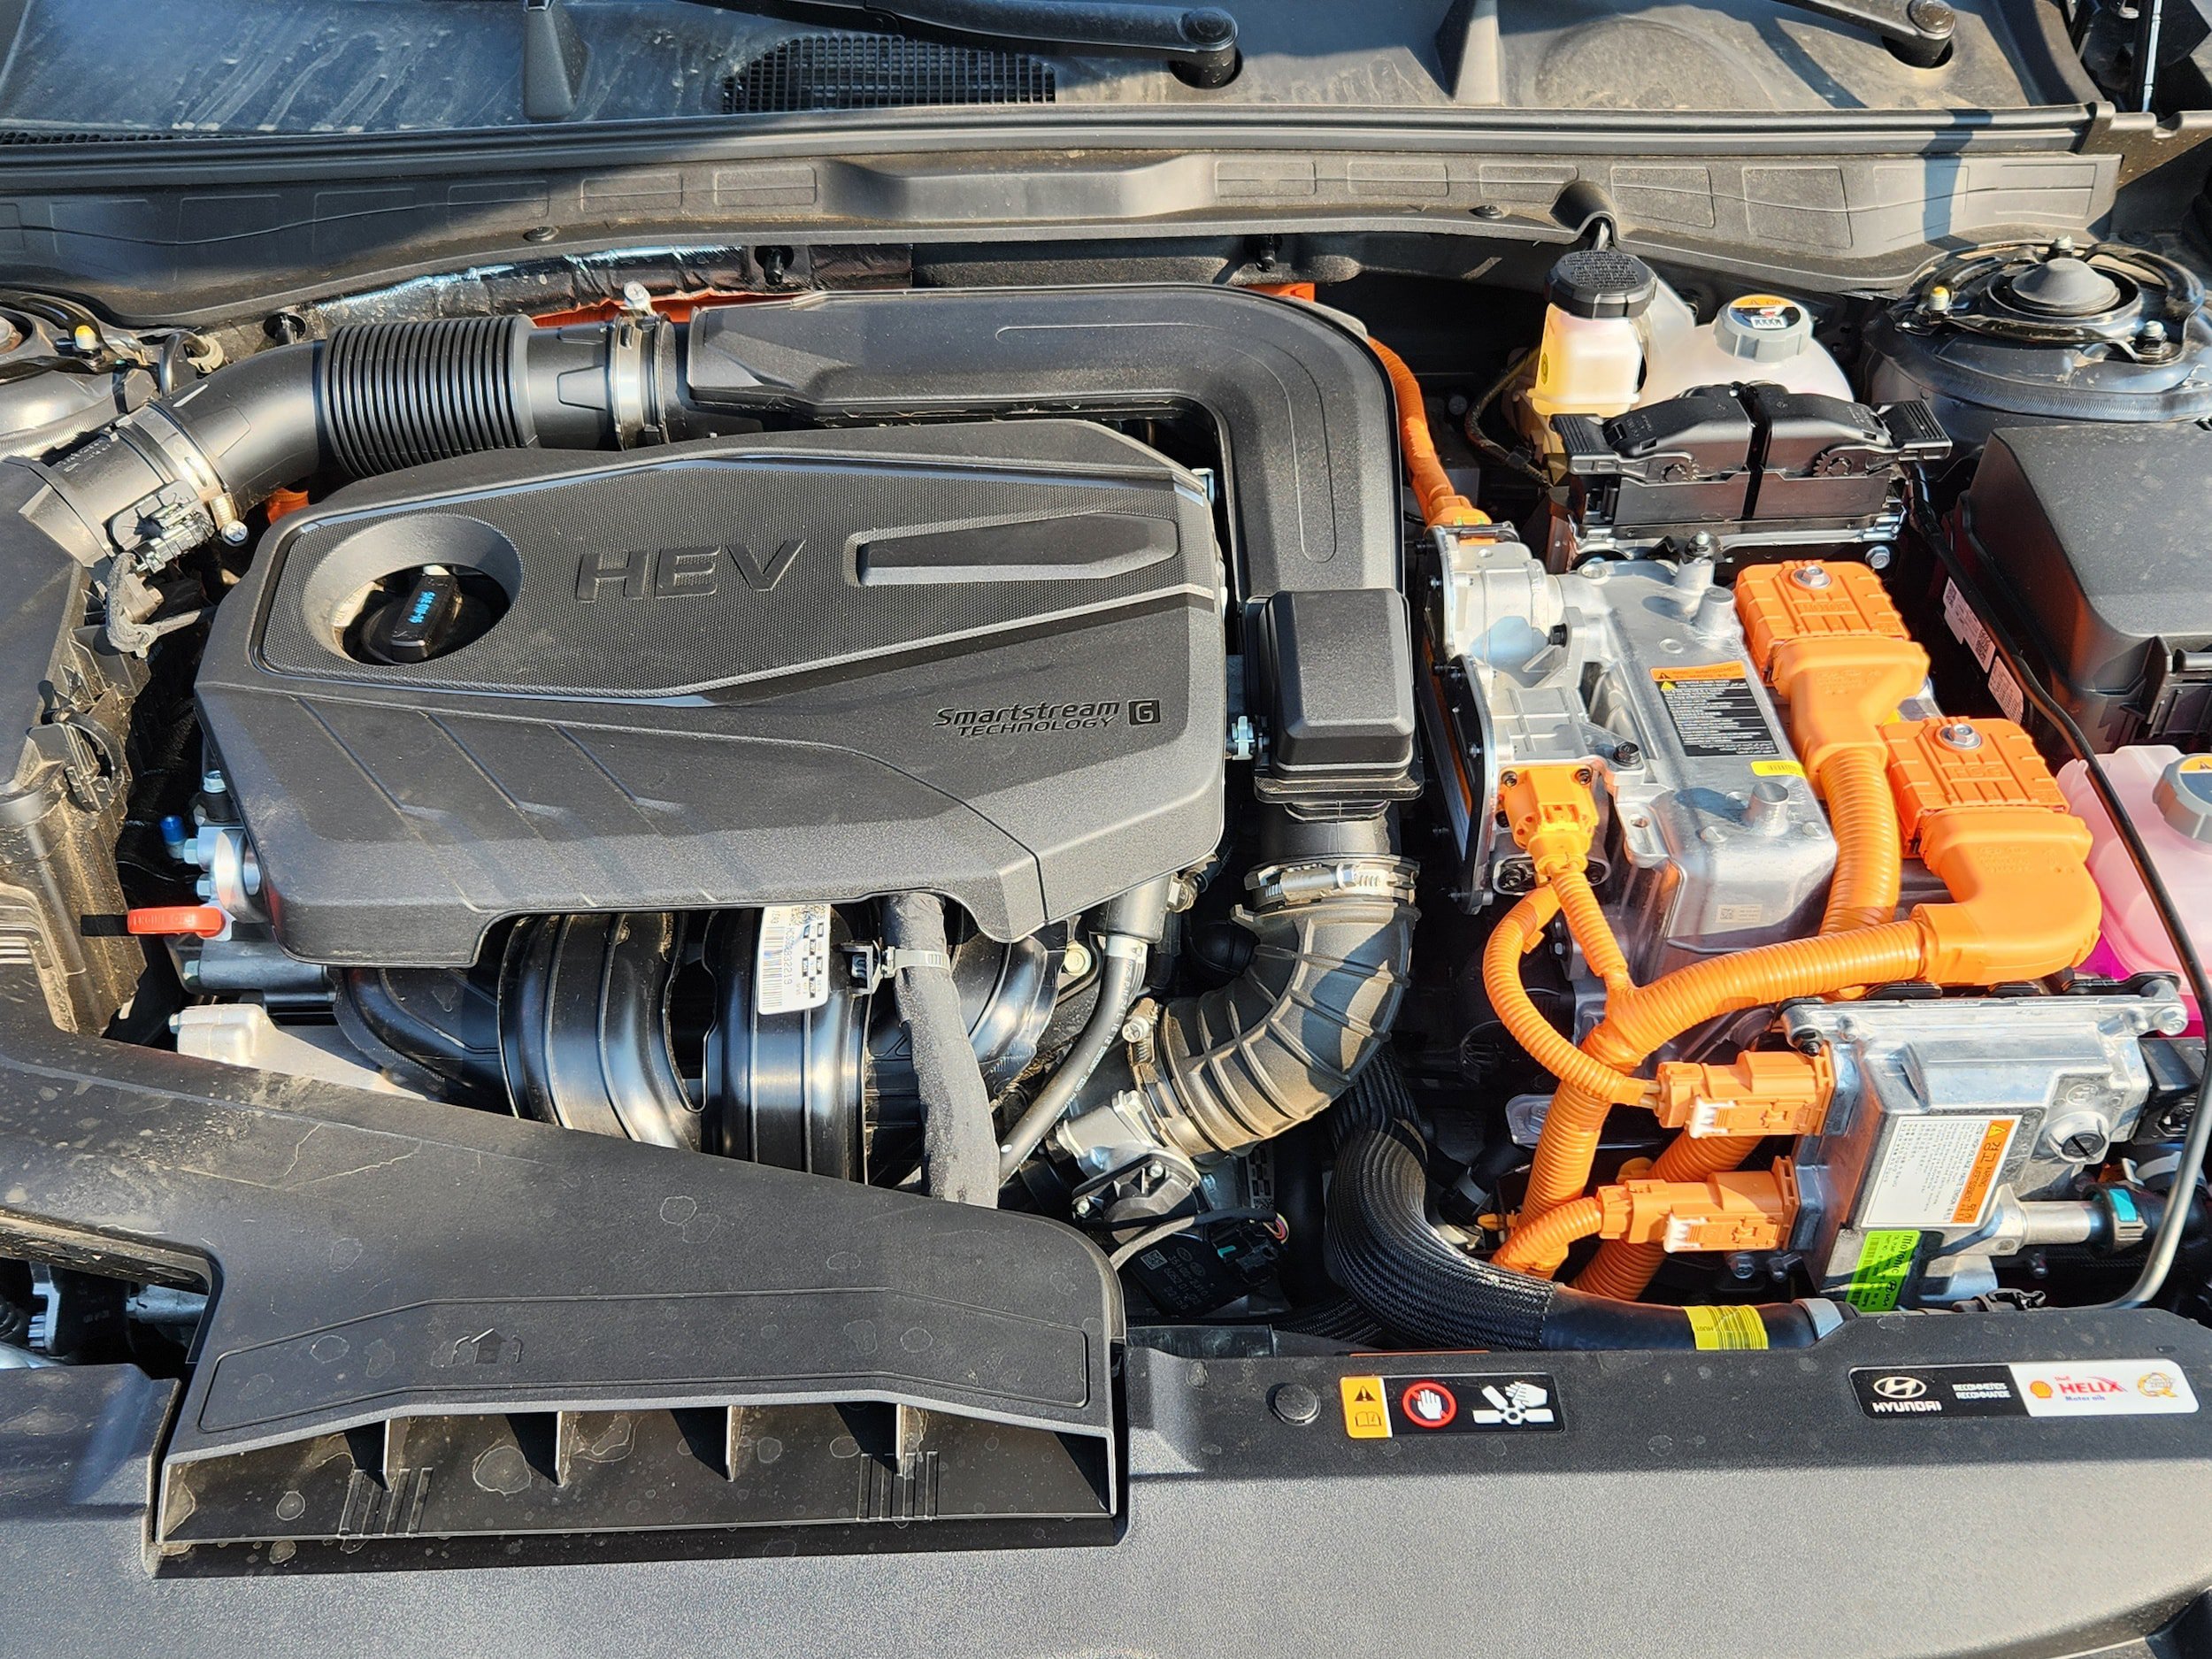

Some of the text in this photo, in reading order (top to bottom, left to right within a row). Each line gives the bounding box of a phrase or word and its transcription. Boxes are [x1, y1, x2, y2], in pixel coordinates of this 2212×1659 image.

[577, 539, 807, 603] HEV
[933, 701, 1120, 726] Smartstream
[958, 717, 1114, 736] TECHNOLOGY
[1954, 766, 2002, 777] HSG
[1977, 1141, 2002, 1163] 경고
[2059, 1380, 2123, 1394] HELIX
[1872, 1401, 1942, 1413] HYUNDAI
